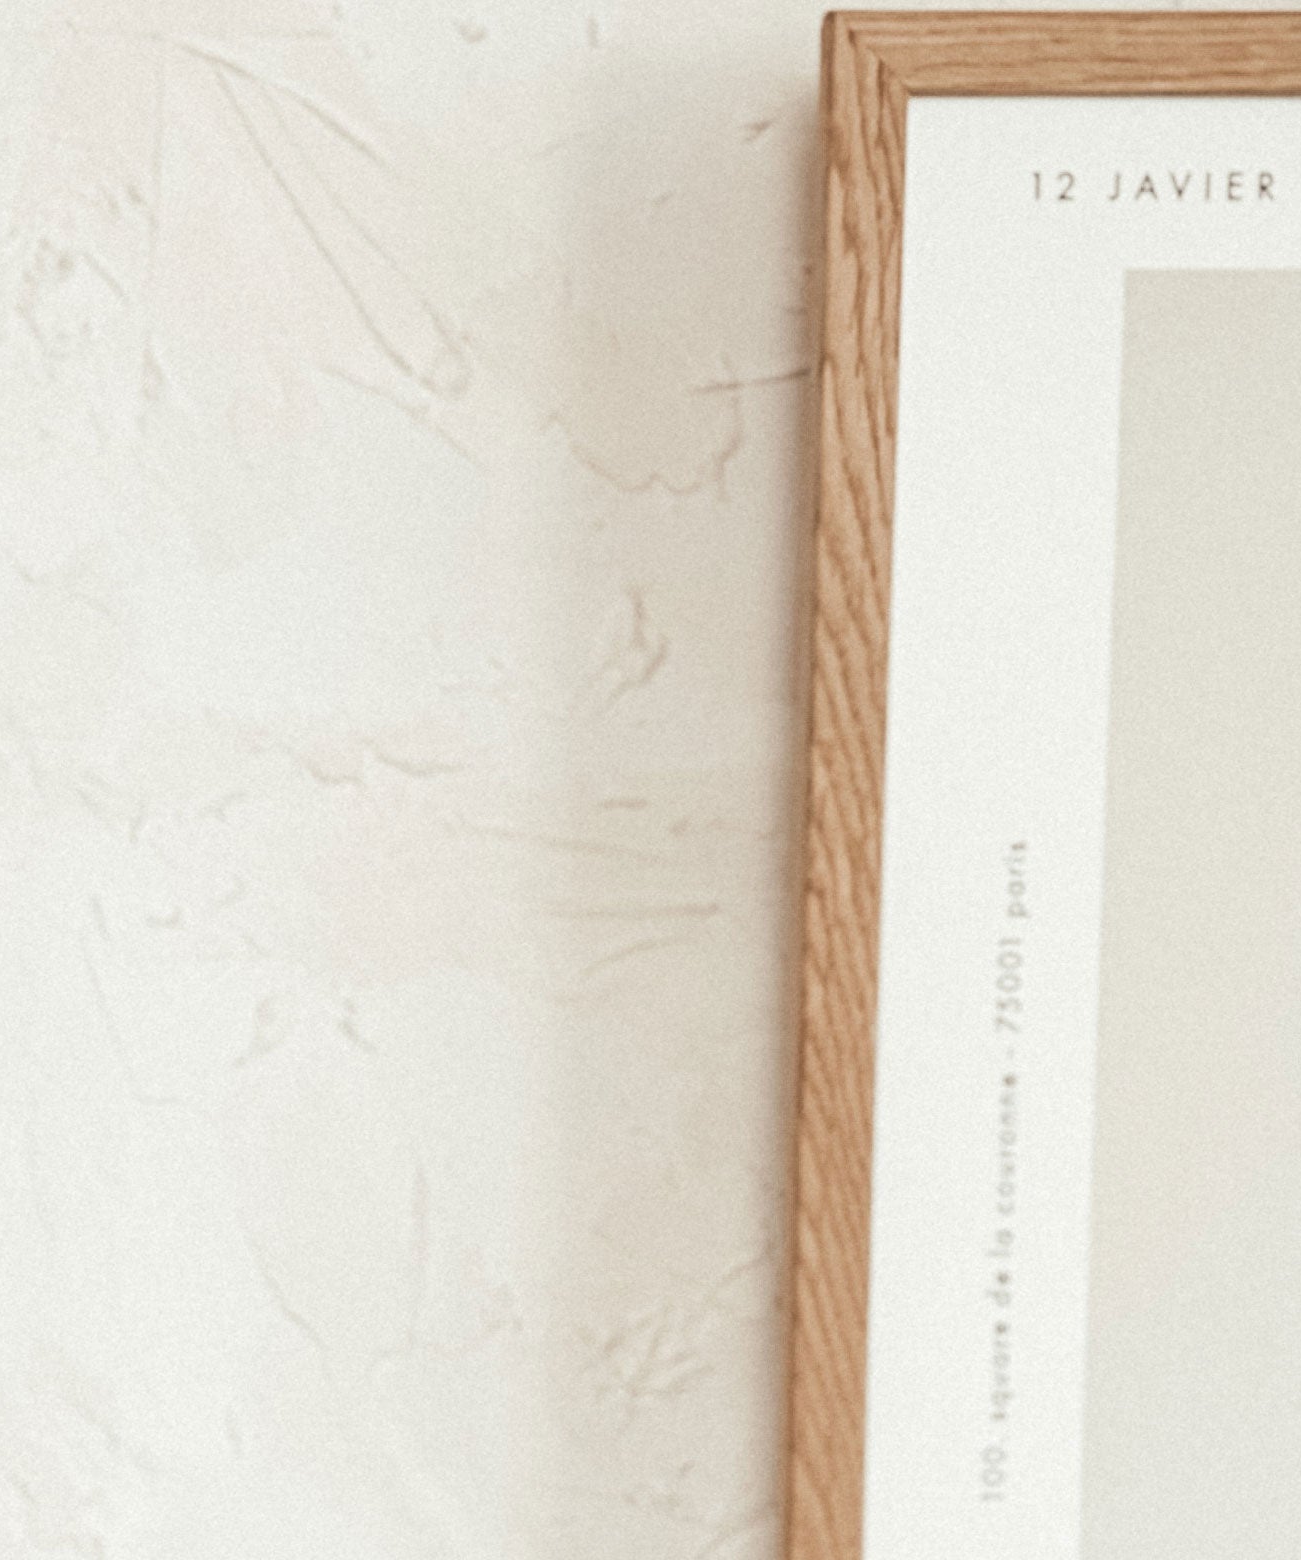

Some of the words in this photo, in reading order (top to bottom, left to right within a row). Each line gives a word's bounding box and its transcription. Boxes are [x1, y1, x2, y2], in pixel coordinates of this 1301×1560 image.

[1032, 171, 1076, 201] 12
[1108, 171, 1276, 201] JAVIER
[986, 1270, 1012, 1307] de
[1001, 840, 1030, 919] paris
